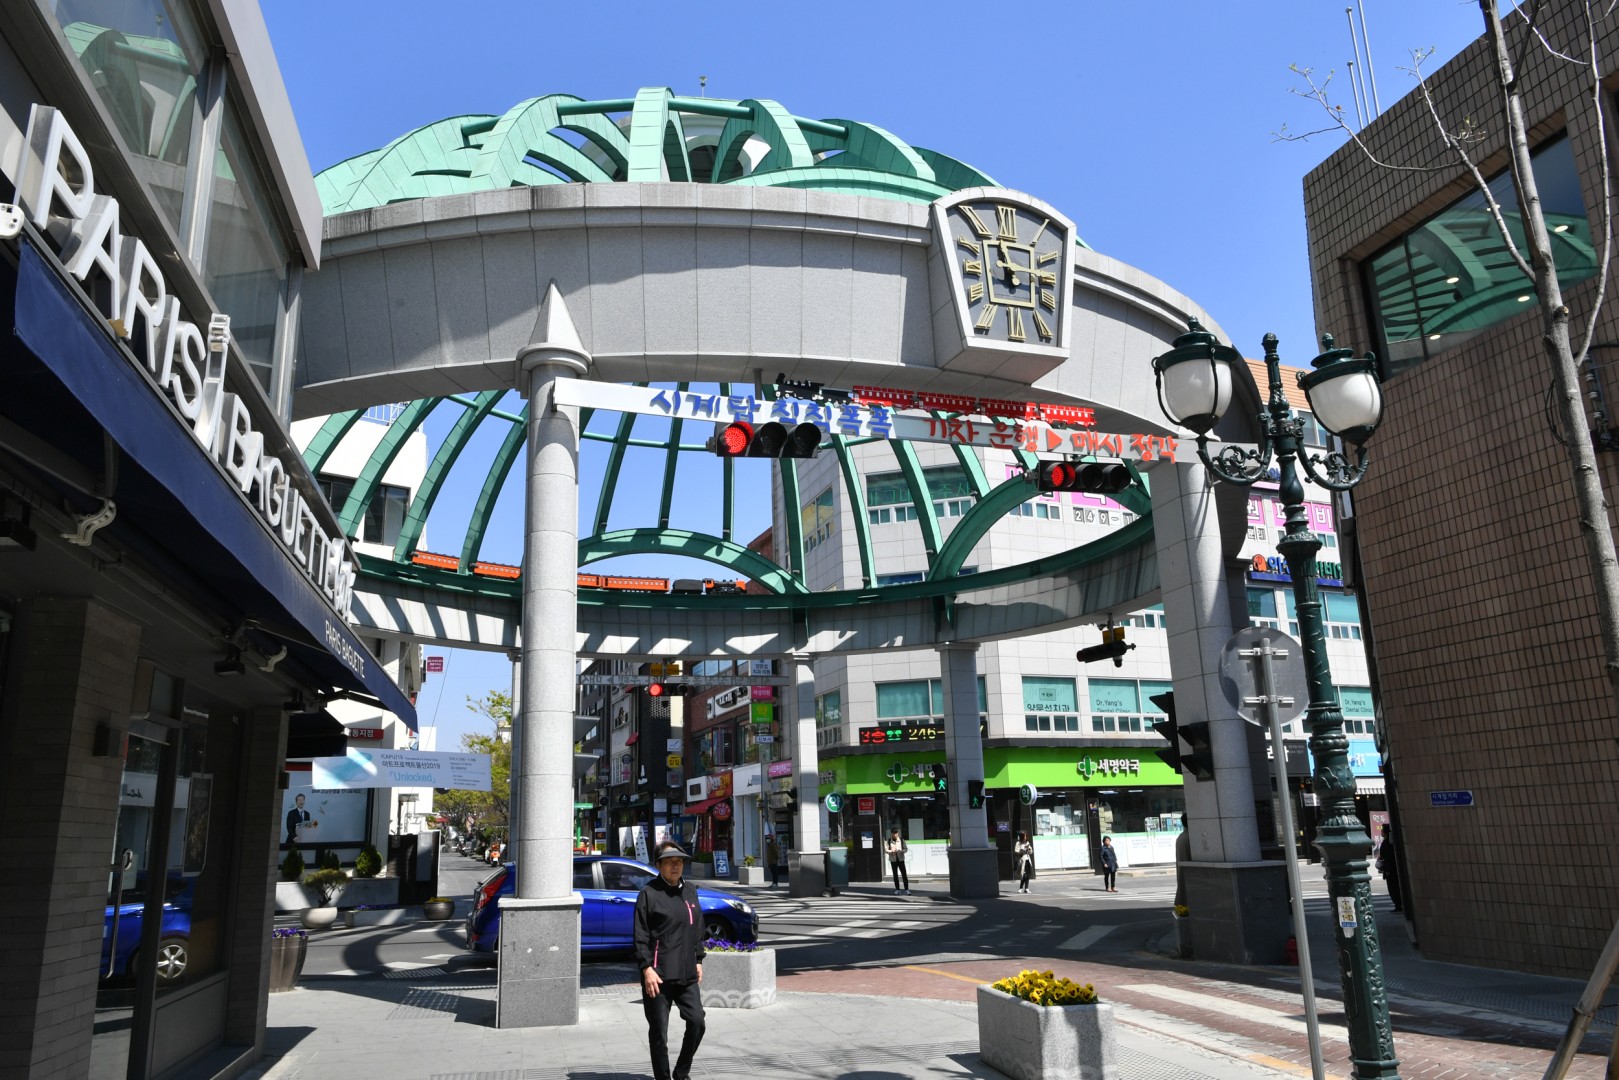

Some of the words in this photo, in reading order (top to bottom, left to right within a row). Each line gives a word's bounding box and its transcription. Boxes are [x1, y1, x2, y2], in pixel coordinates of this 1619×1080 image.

[14, 103, 206, 420] PARIS
[224, 393, 335, 600] BAGUETTE
[649, 390, 761, 424] 시계탑
[922, 418, 979, 443] 기차
[989, 421, 1039, 453] 운행
[1070, 430, 1123, 456] 매시
[1130, 433, 1178, 464] 정각
[325, 620, 341, 655] PARIS
[342, 638, 366, 679] BAGUETTE
[1096, 699, 1123, 707] Dr.Yang's
[1098, 759, 1140, 777] 세명약국
